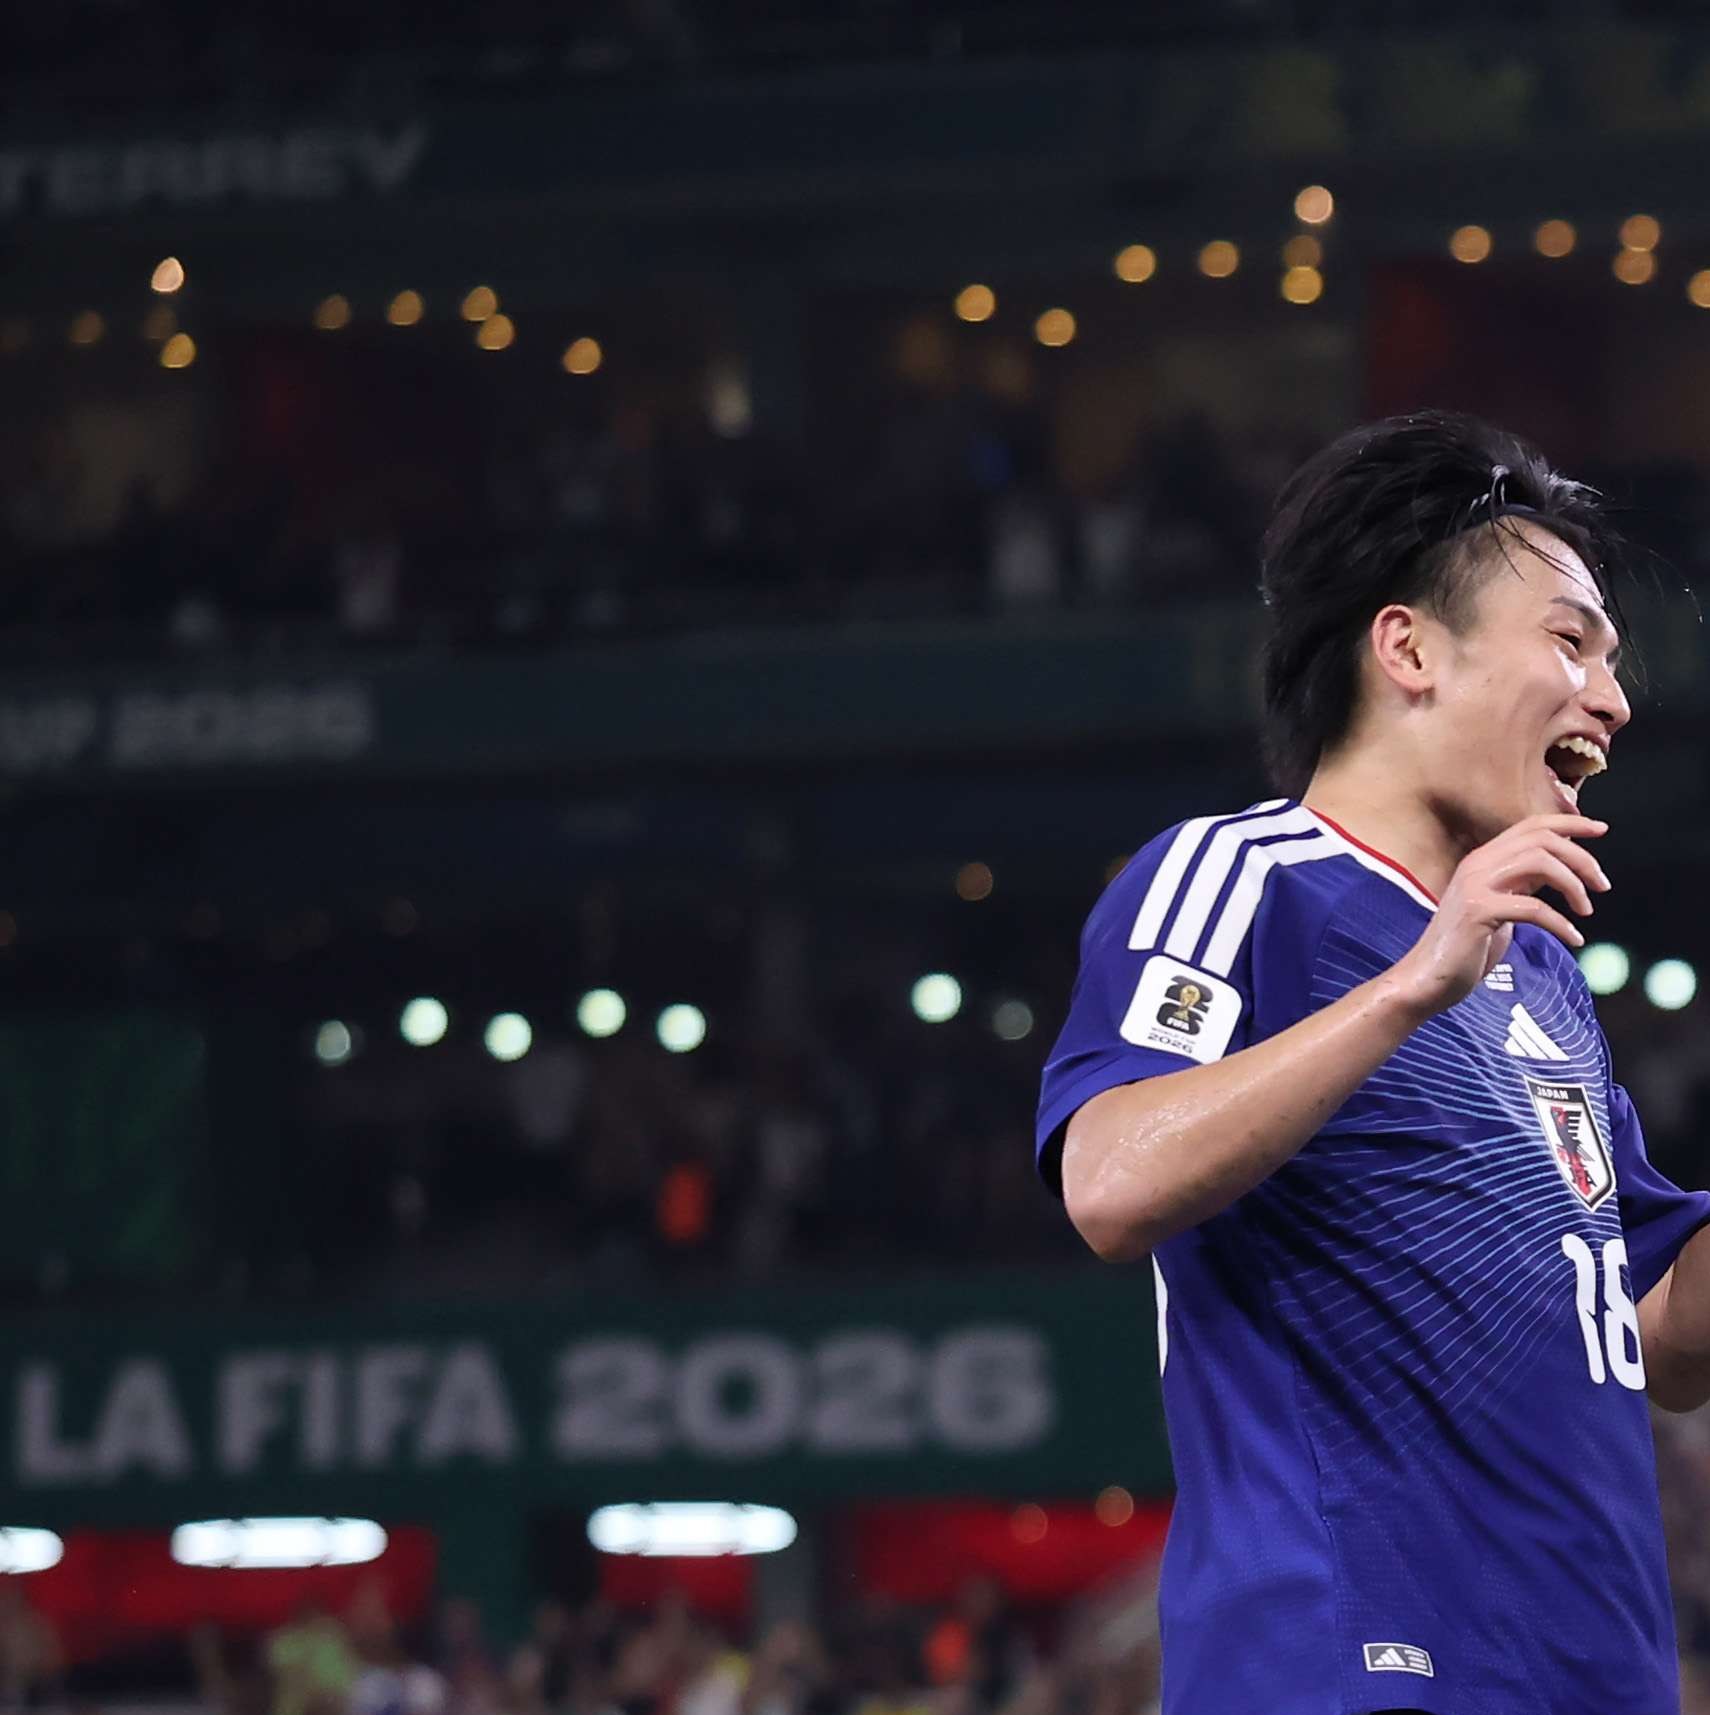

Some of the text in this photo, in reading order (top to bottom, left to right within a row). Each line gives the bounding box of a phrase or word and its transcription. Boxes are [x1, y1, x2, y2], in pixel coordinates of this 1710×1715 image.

[1147, 1033, 1193, 1054] 2026
[1537, 1086, 1569, 1100] JAPAN
[1561, 1233, 1646, 1390] 18
[16, 1325, 1056, 1477] LA FIFA 2026
